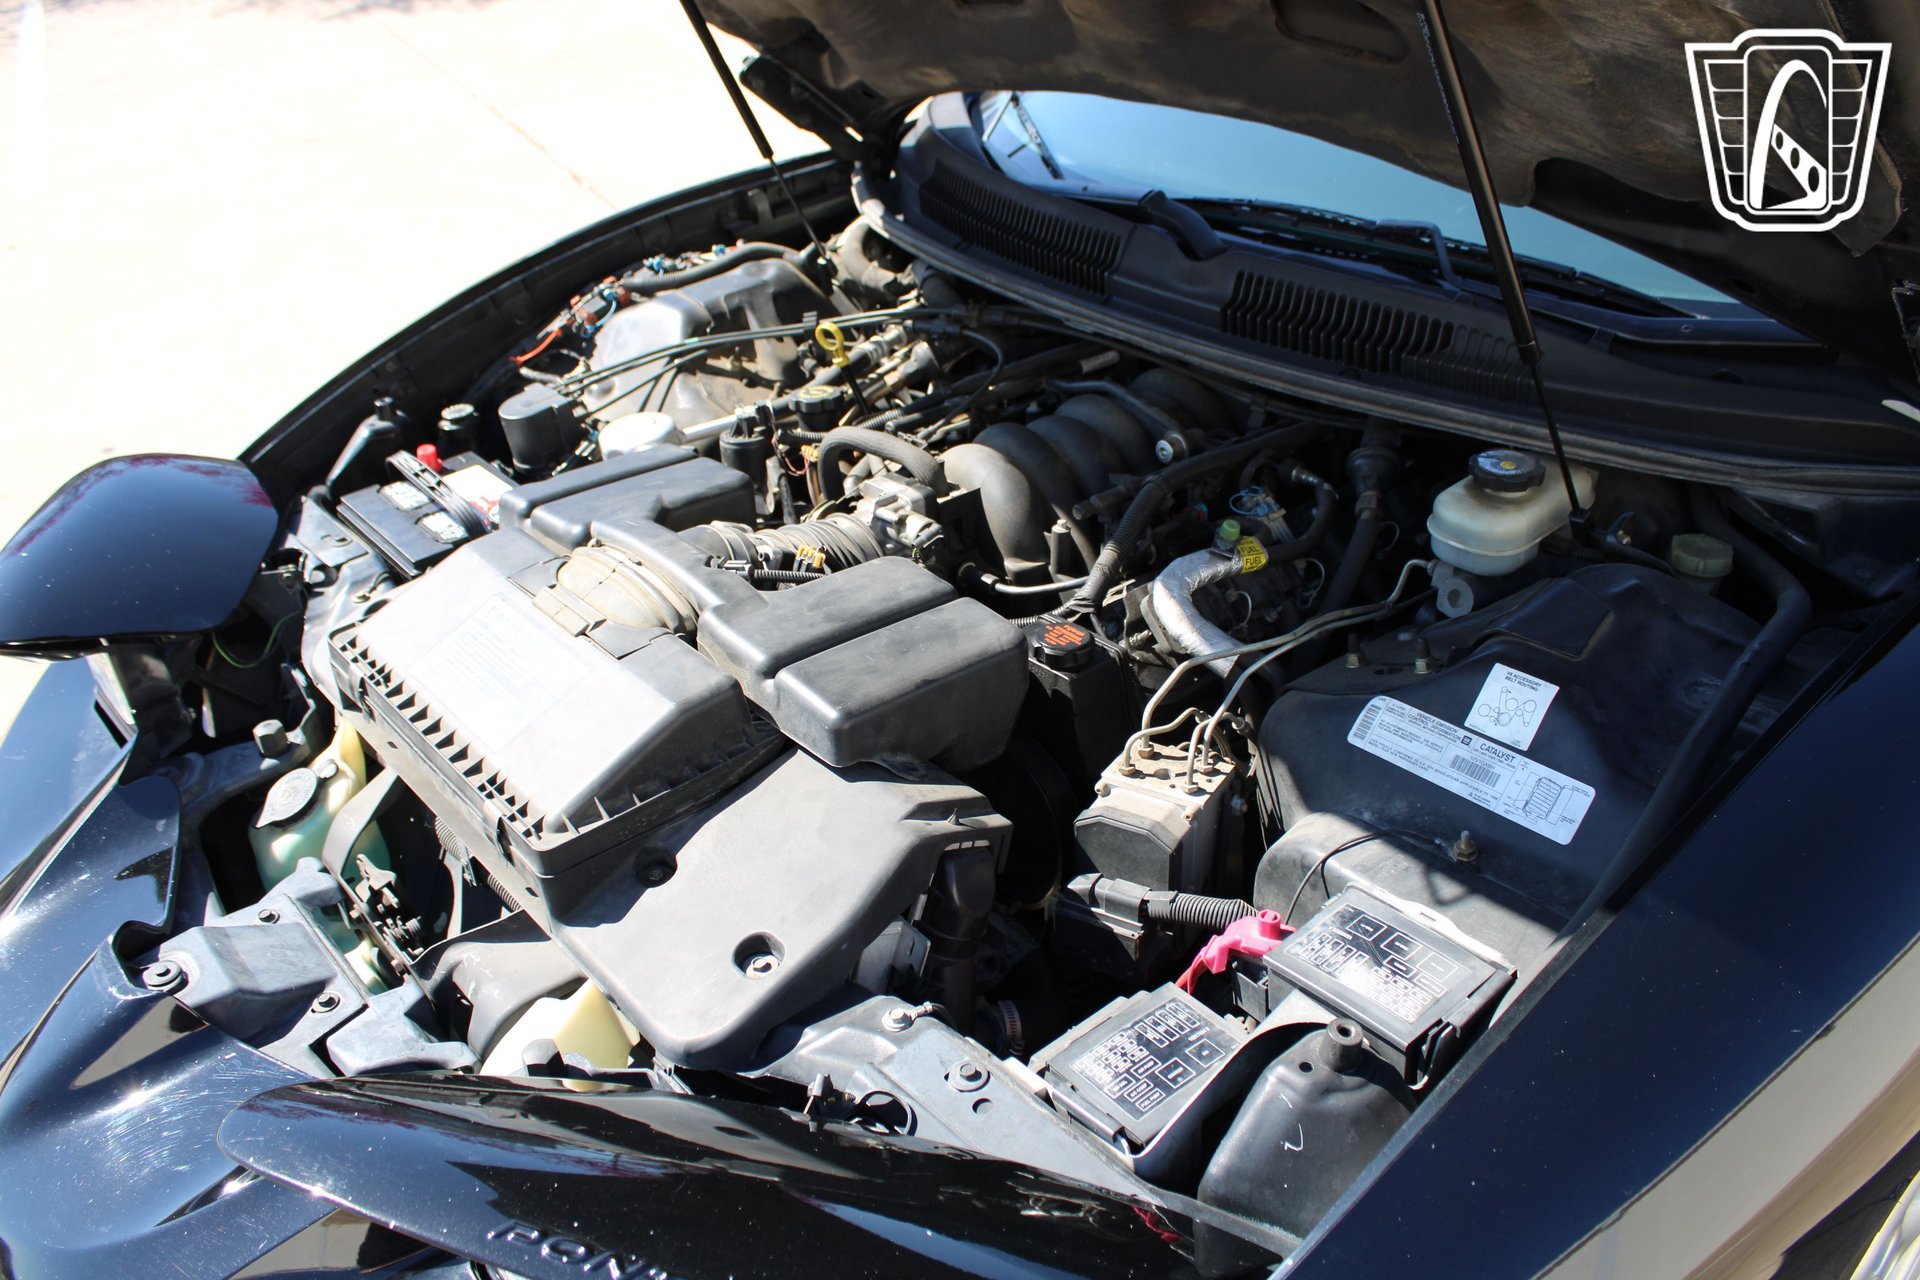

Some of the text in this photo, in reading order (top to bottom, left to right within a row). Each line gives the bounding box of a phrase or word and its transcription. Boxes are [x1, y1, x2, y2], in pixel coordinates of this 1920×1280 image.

[1245, 556, 1262, 566] FUEL
[1505, 675, 1538, 692] BELT ROUTING
[1513, 673, 1541, 688] ACCESSORY
[1408, 714, 1429, 726] CONTROL
[1430, 724, 1461, 741] INFORMATION
[1416, 712, 1436, 723] VEHICLE
[1436, 721, 1457, 733] EMISSION
[1479, 742, 1516, 763] CATALYST
